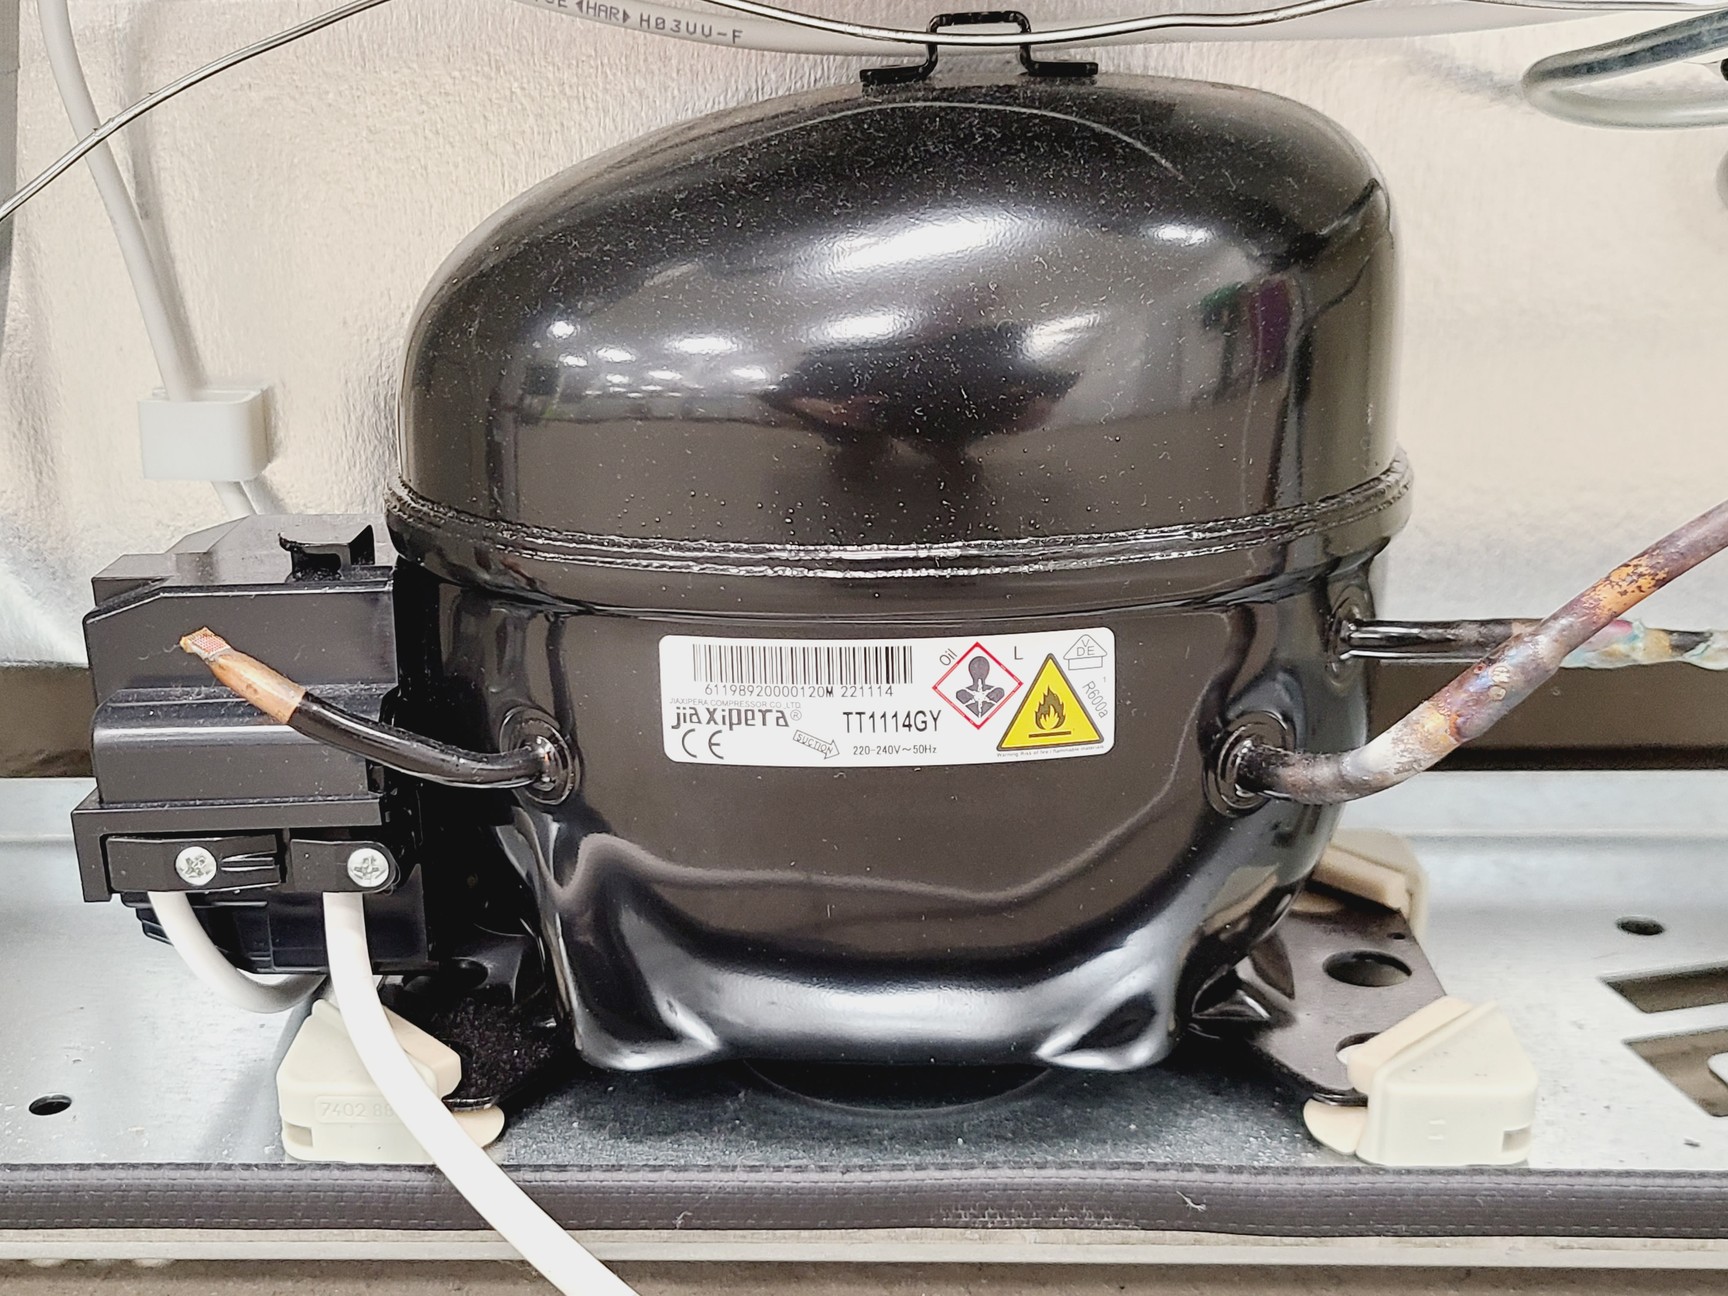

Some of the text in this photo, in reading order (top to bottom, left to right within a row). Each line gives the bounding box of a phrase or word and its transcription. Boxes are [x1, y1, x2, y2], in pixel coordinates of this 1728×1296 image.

[938, 648, 958, 667] Oil
[1013, 645, 1024, 661] L
[704, 683, 894, 699] 61198920000120M 221114
[1082, 680, 1109, 719] R600a
[669, 697, 709, 706] JIAXIPERA
[710, 699, 767, 708] COMPRESSOR
[842, 709, 942, 734] TT1114GY
[796, 732, 834, 755] SUCTION
[320, 1102, 369, 1117] 7402
